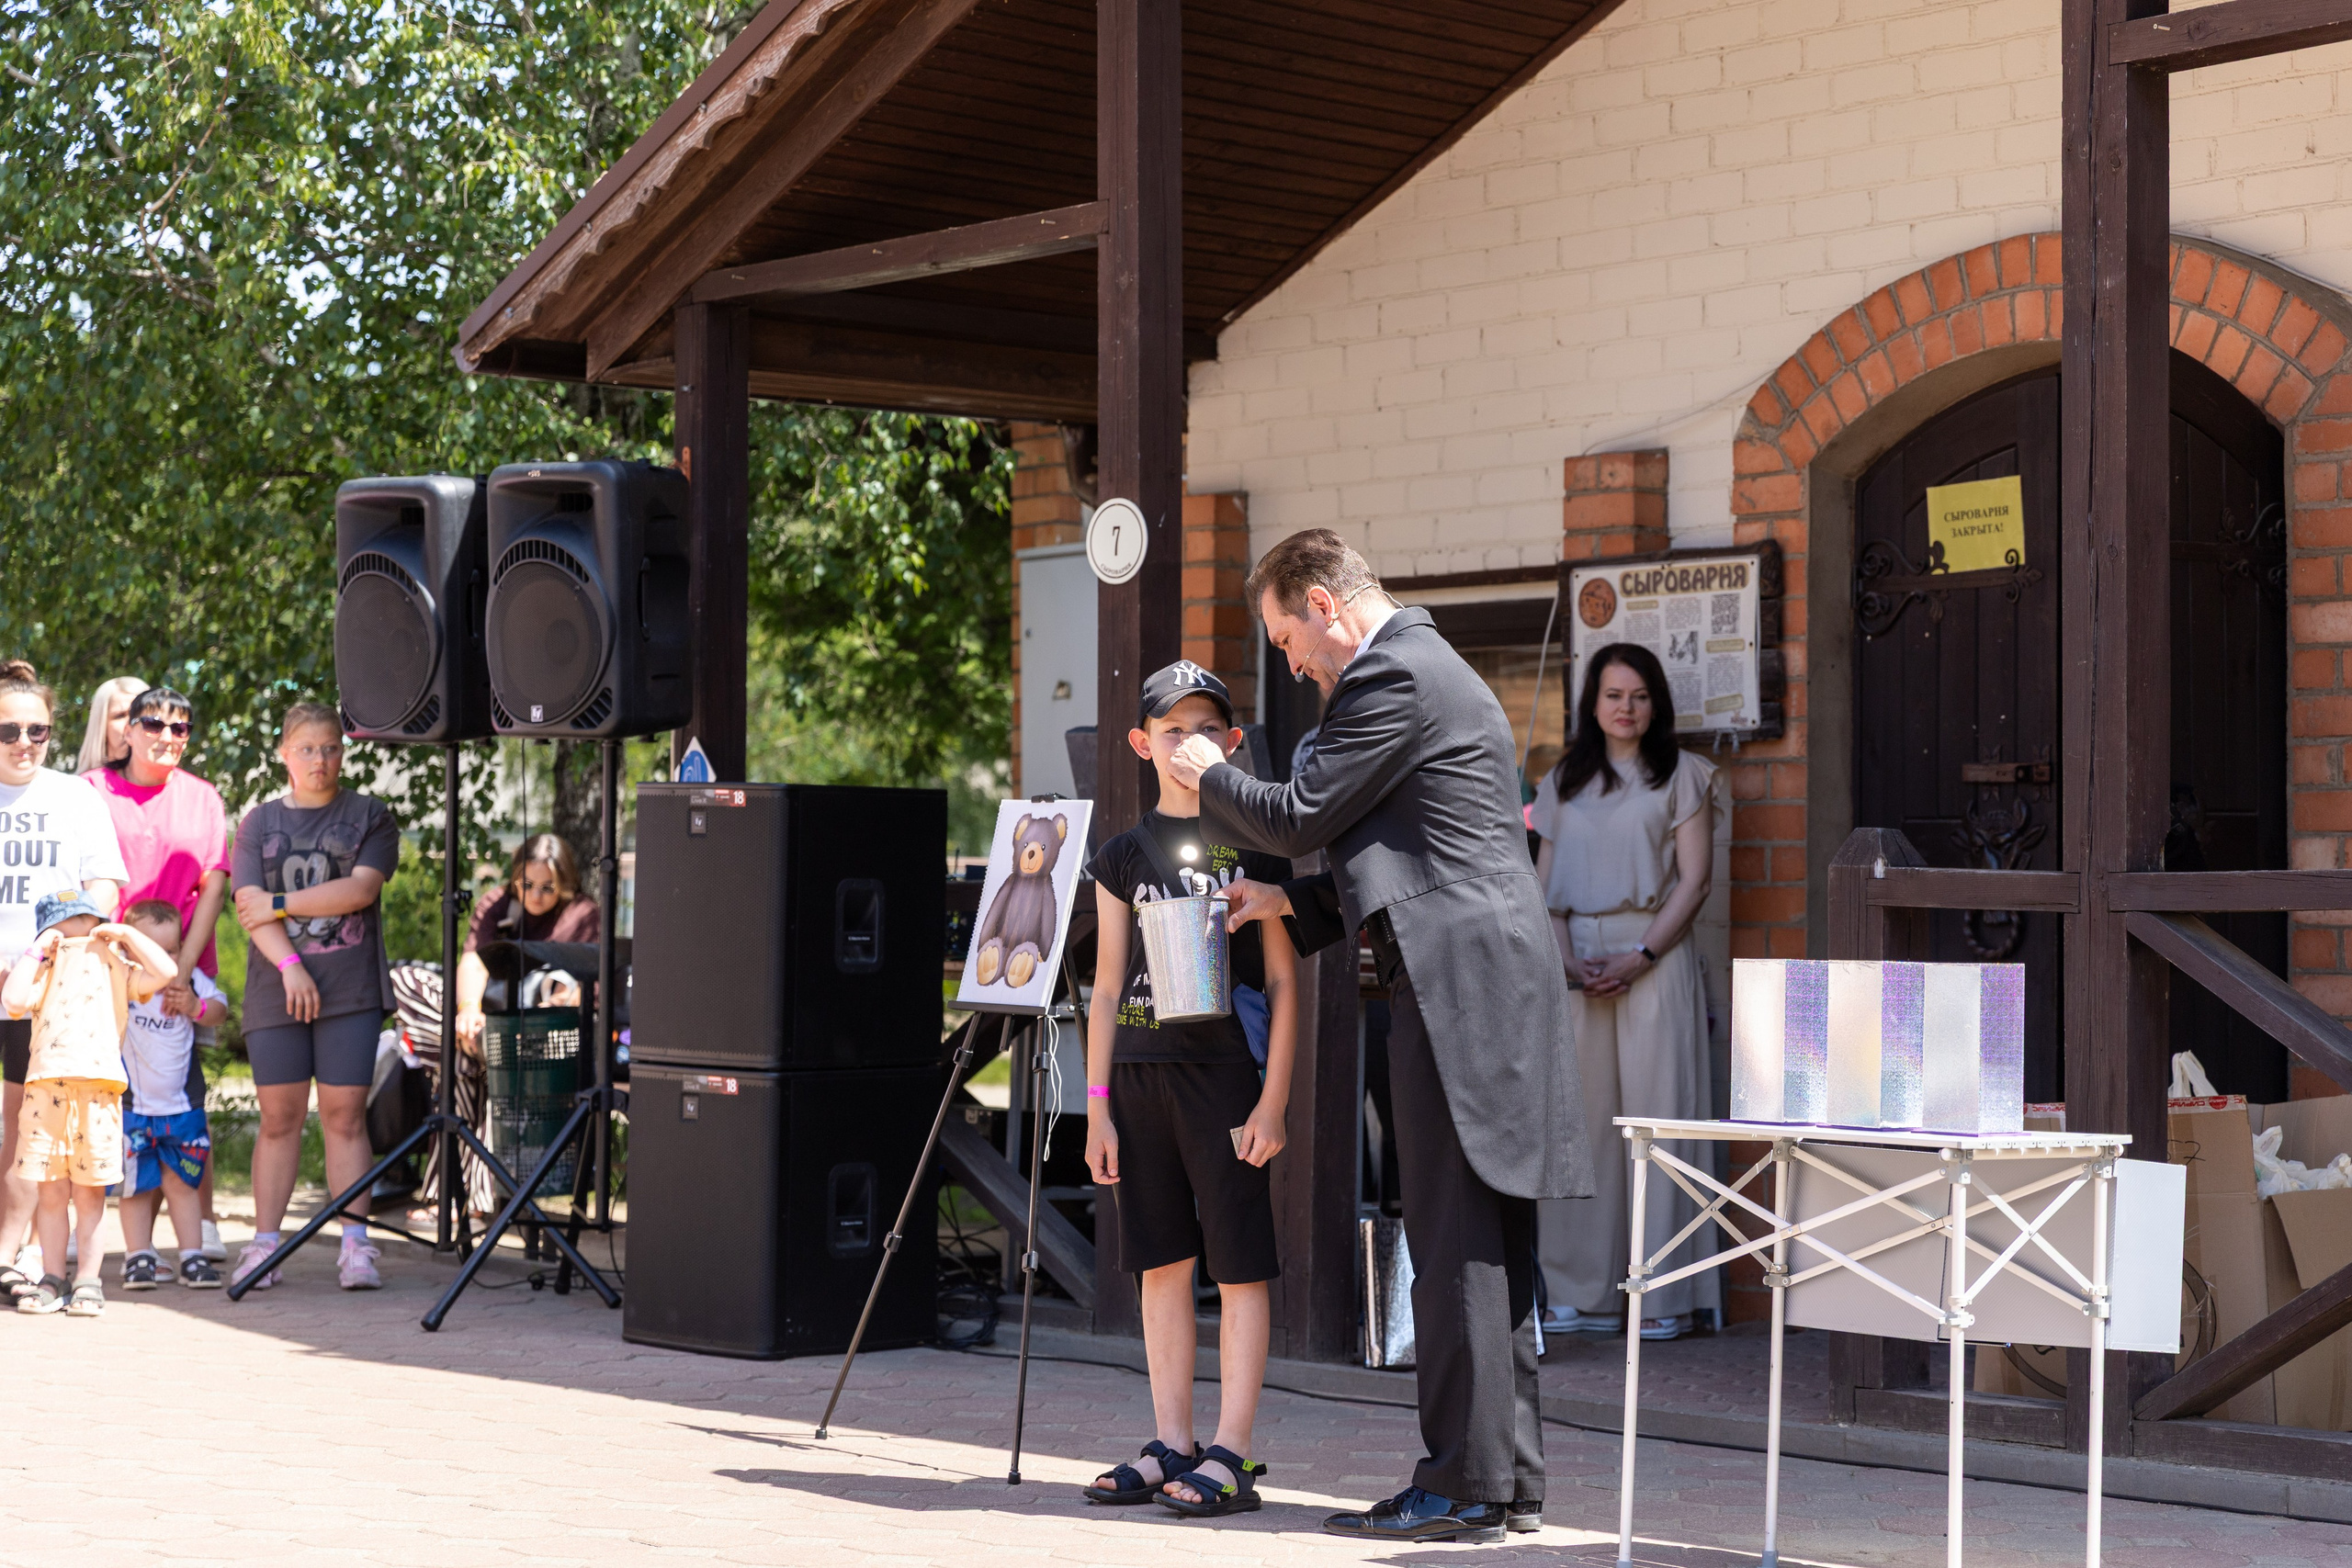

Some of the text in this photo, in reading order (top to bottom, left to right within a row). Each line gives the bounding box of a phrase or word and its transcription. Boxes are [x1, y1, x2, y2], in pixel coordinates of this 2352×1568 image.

[1943, 505, 2009, 523] СЫРОВАРНЯ
[1951, 523, 2004, 538] ЗАКРЫТА!
[1112, 525, 1121, 557] 7
[1622, 564, 1747, 595] СЫРОВАРНЯ
[1172, 661, 1207, 687] NY
[733, 790, 744, 805] 18
[4, 840, 62, 867] OUT
[1206, 844, 1238, 861] DREAM
[1129, 1015, 1148, 1028] WITH
[1149, 1020, 1160, 1030] US
[726, 1077, 737, 1093] 18
